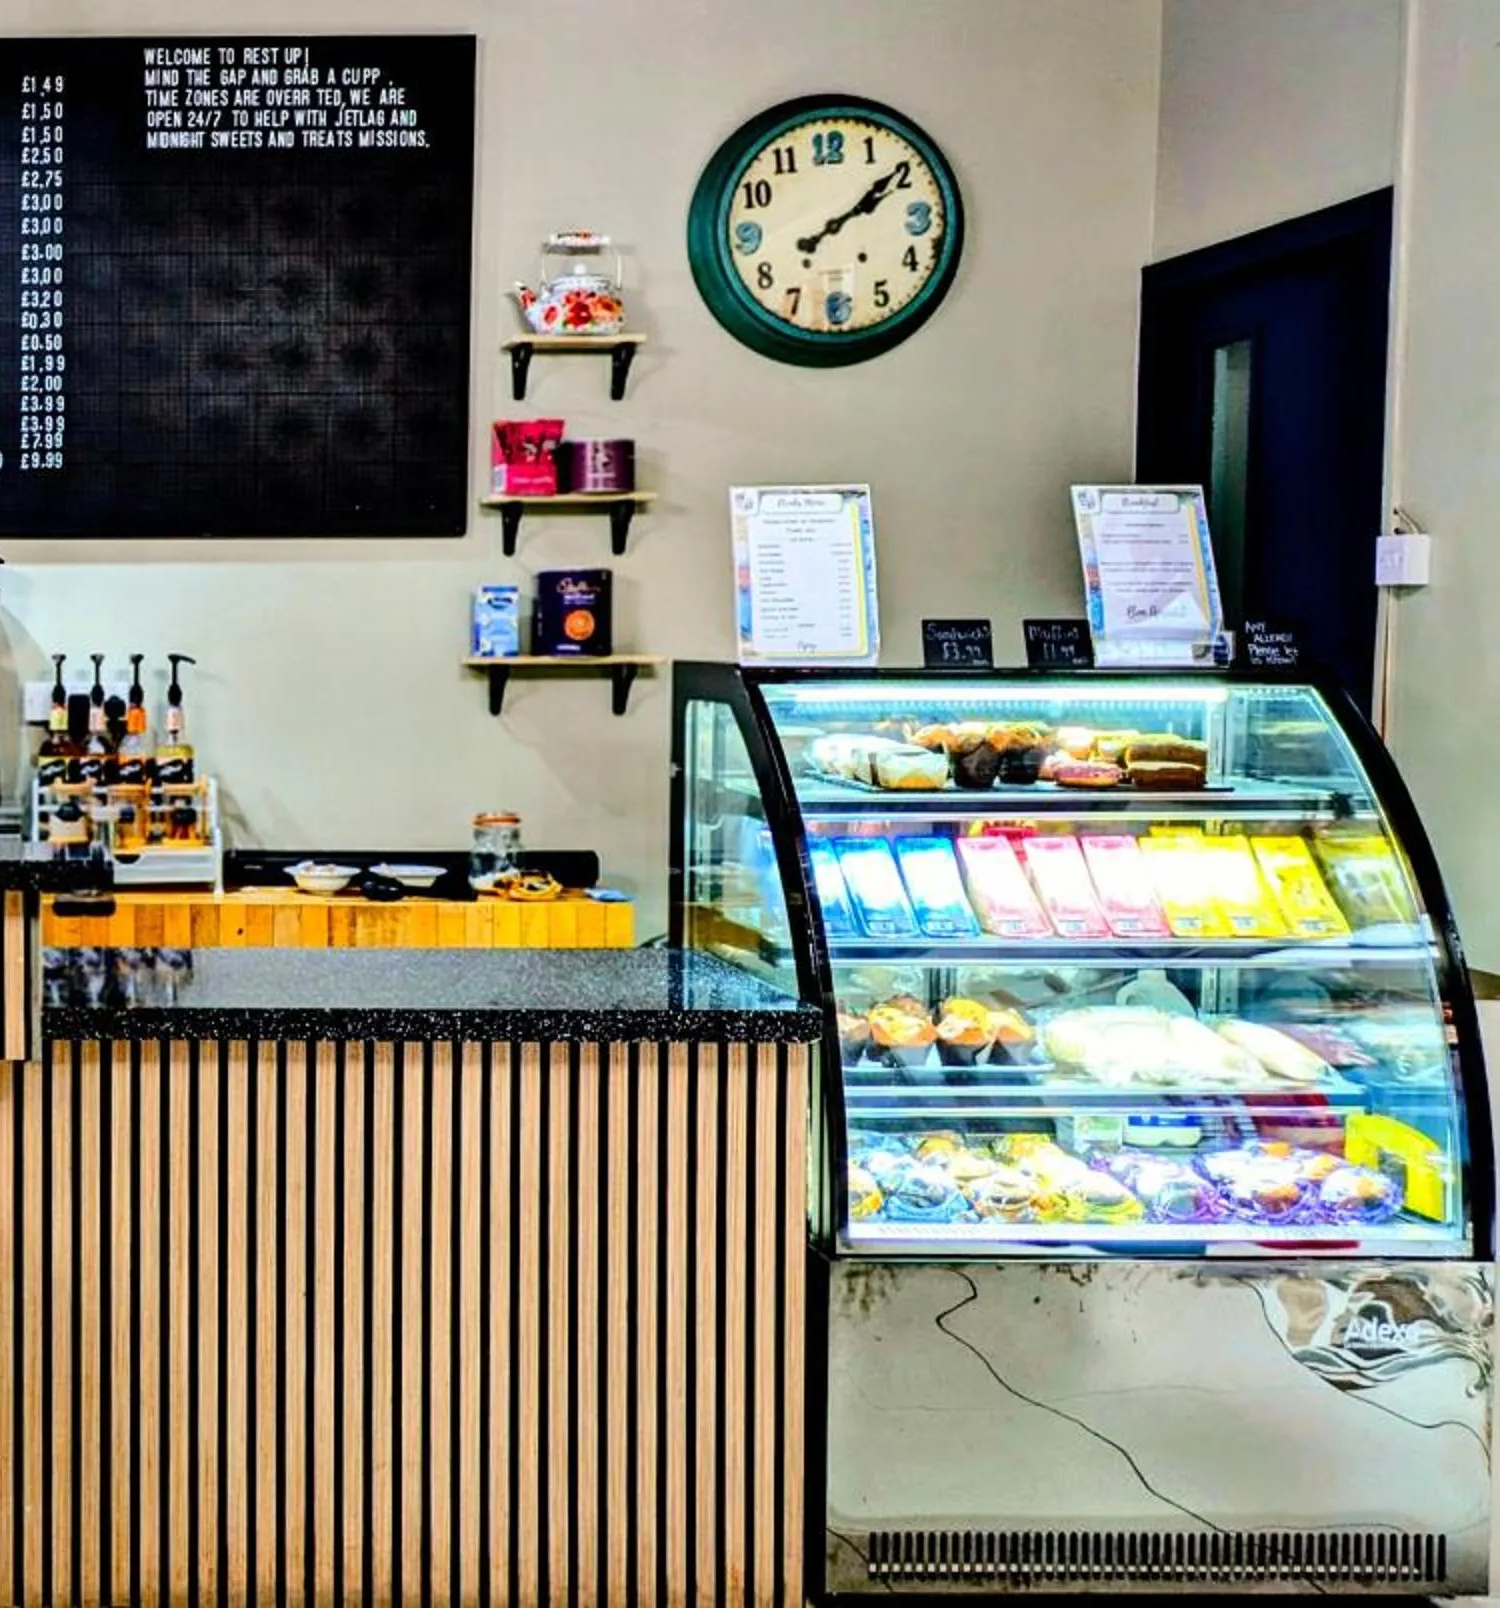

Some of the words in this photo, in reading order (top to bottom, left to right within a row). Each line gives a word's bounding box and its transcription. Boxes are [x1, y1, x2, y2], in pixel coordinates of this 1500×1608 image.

[145, 48, 210, 65] WELCOME
[219, 48, 234, 64] TO
[244, 48, 278, 64] REST
[285, 48, 308, 68] UP!
[145, 69, 178, 86] MIND
[186, 68, 210, 85] THE
[220, 69, 246, 85] GAP
[252, 69, 277, 85] AND
[284, 68, 318, 85] GRAB
[328, 69, 335, 84] A
[146, 90, 178, 106] TIME
[186, 89, 228, 106] ZONES
[234, 89, 259, 106] ARE
[350, 88, 370, 105] WE
[380, 88, 404, 104] ARE
[148, 110, 181, 127] OPEN
[188, 111, 221, 127] 24/7
[232, 110, 248, 126] TO
[255, 110, 289, 127] HELP
[294, 109, 326, 126] WITH
[335, 108, 384, 126] JETLAG
[390, 110, 416, 126] AND
[148, 132, 205, 148] MIDNIGHT
[211, 131, 262, 147] SWEETS
[268, 131, 294, 147] AND
[302, 130, 352, 147] TREATS
[812, 131, 844, 165] 12
[864, 137, 876, 164] 1
[773, 146, 798, 175] 11
[896, 162, 912, 188] 2
[742, 180, 772, 208] 10
[904, 202, 932, 236] 3
[735, 222, 762, 255] 9
[902, 246, 918, 272] 4
[757, 262, 773, 289] 8
[786, 288, 801, 316] 7
[874, 280, 890, 307] 5
[825, 292, 852, 325] 6
